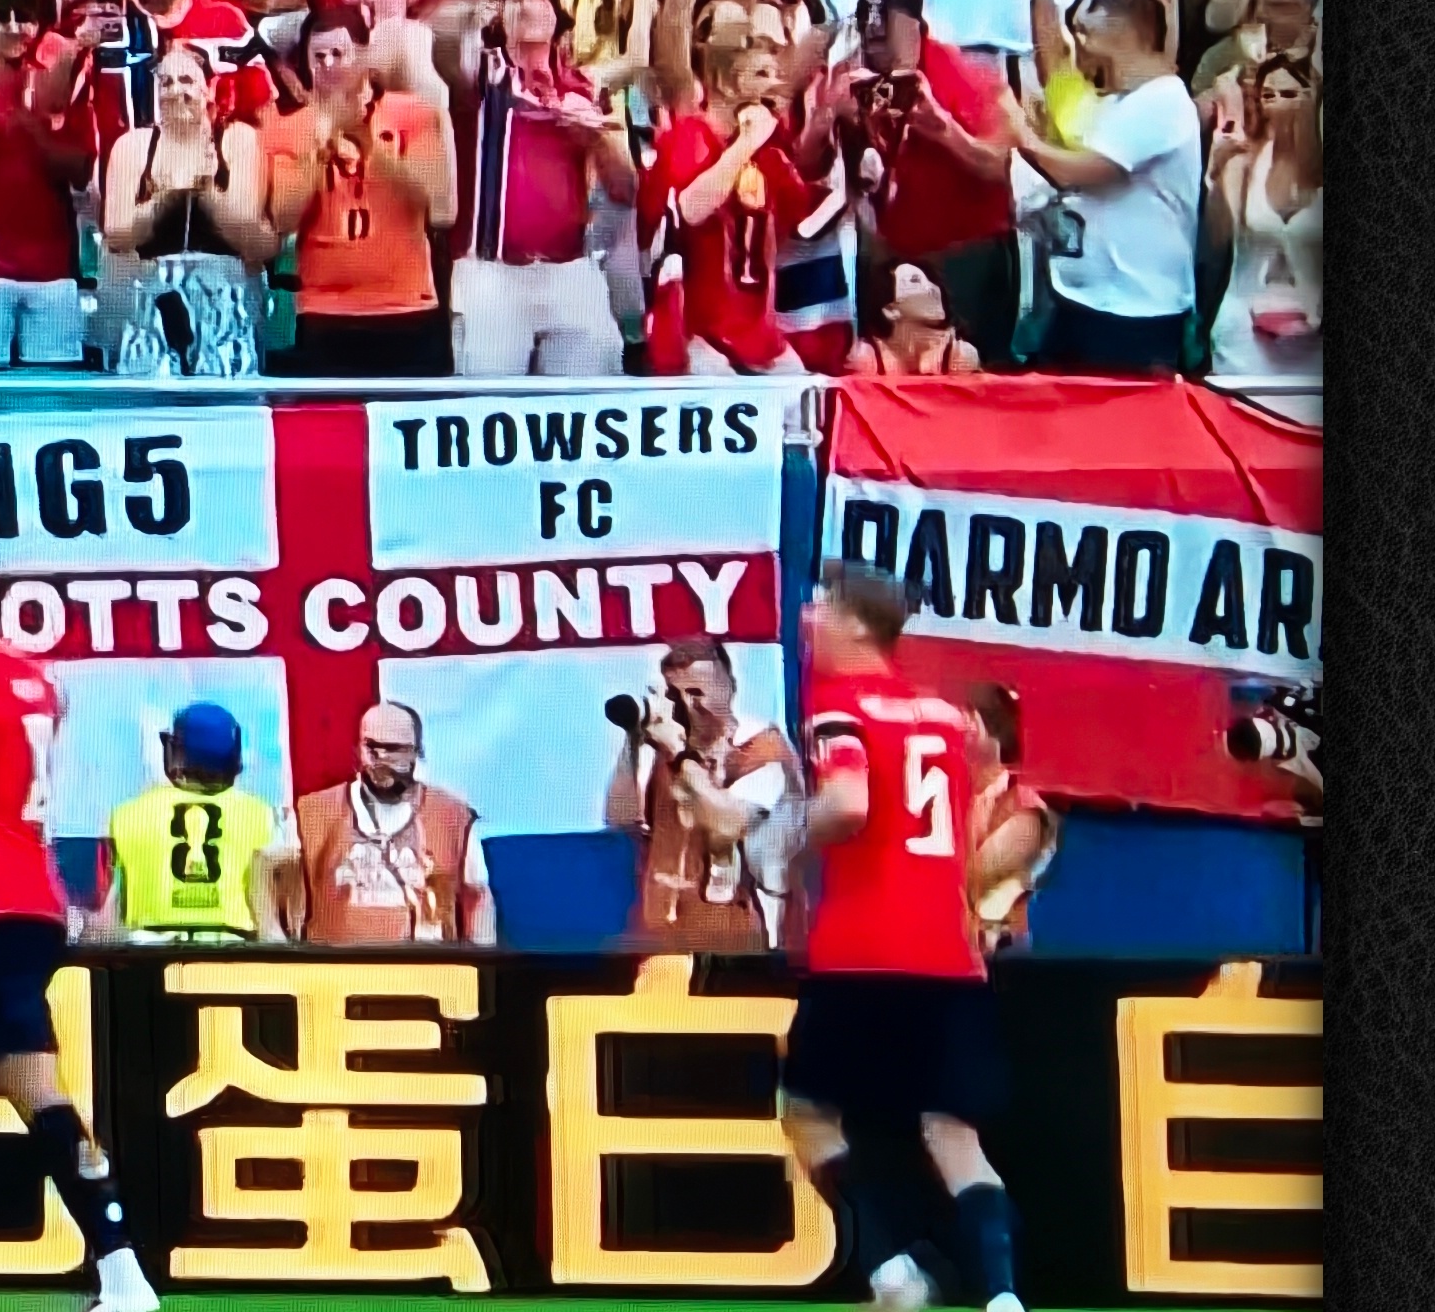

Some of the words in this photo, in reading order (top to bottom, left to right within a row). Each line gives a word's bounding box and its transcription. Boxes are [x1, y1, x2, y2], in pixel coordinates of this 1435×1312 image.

[392, 403, 758, 471] TROWSERS
[539, 478, 613, 541] FC
[0, 576, 270, 656] OTTS
[303, 560, 750, 653] COUNTY
[1188, 539, 1323, 660] AR
[903, 734, 956, 857] 5
